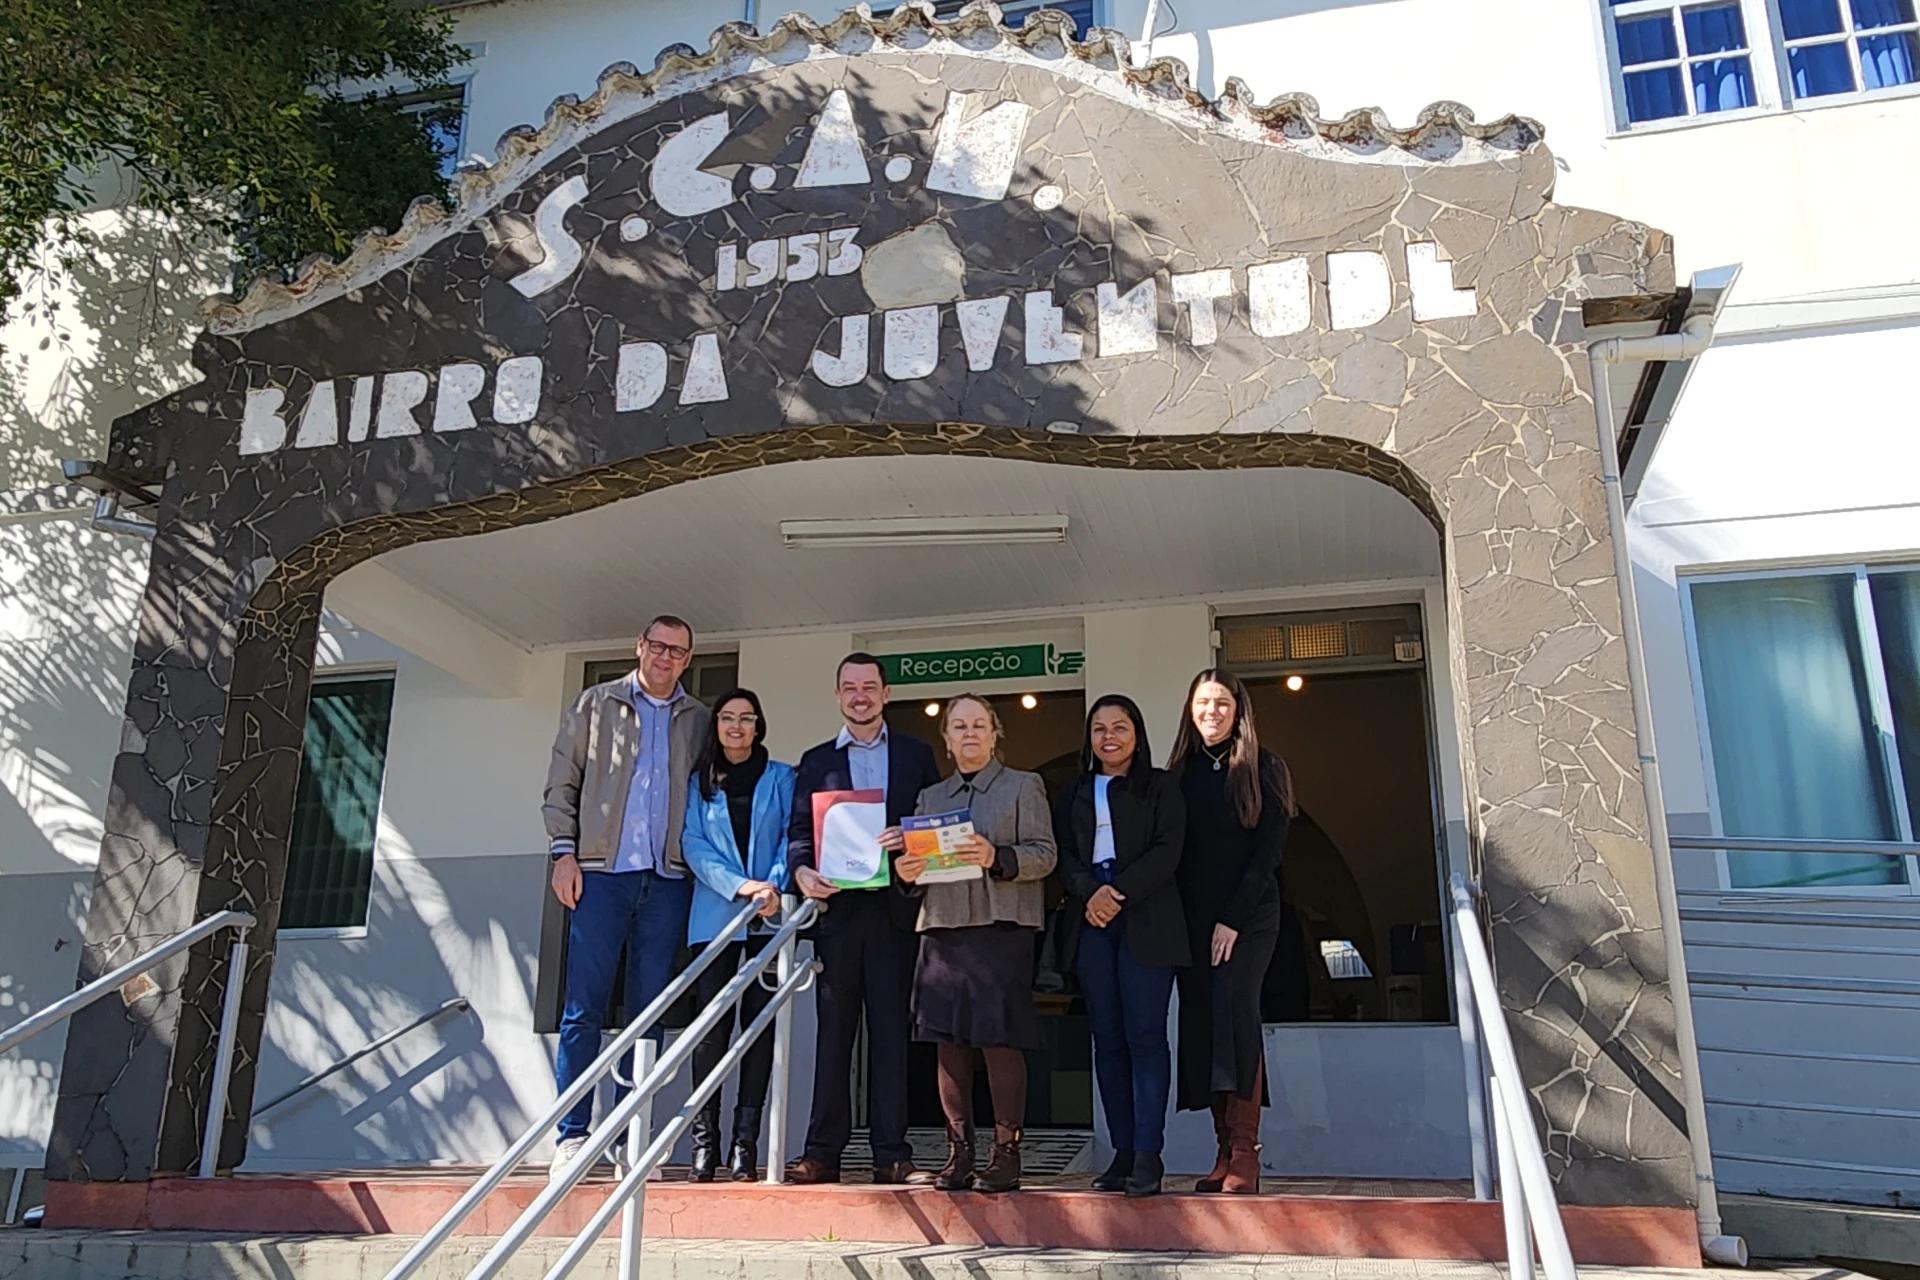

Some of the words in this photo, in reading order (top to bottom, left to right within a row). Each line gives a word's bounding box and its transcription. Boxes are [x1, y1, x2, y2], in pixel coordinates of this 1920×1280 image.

[715, 226, 865, 291] 1953
[238, 355, 544, 456] BAIRRO
[615, 333, 731, 412] DA
[811, 240, 1479, 388] JUVENTUDE
[900, 652, 1021, 677] Recepção
